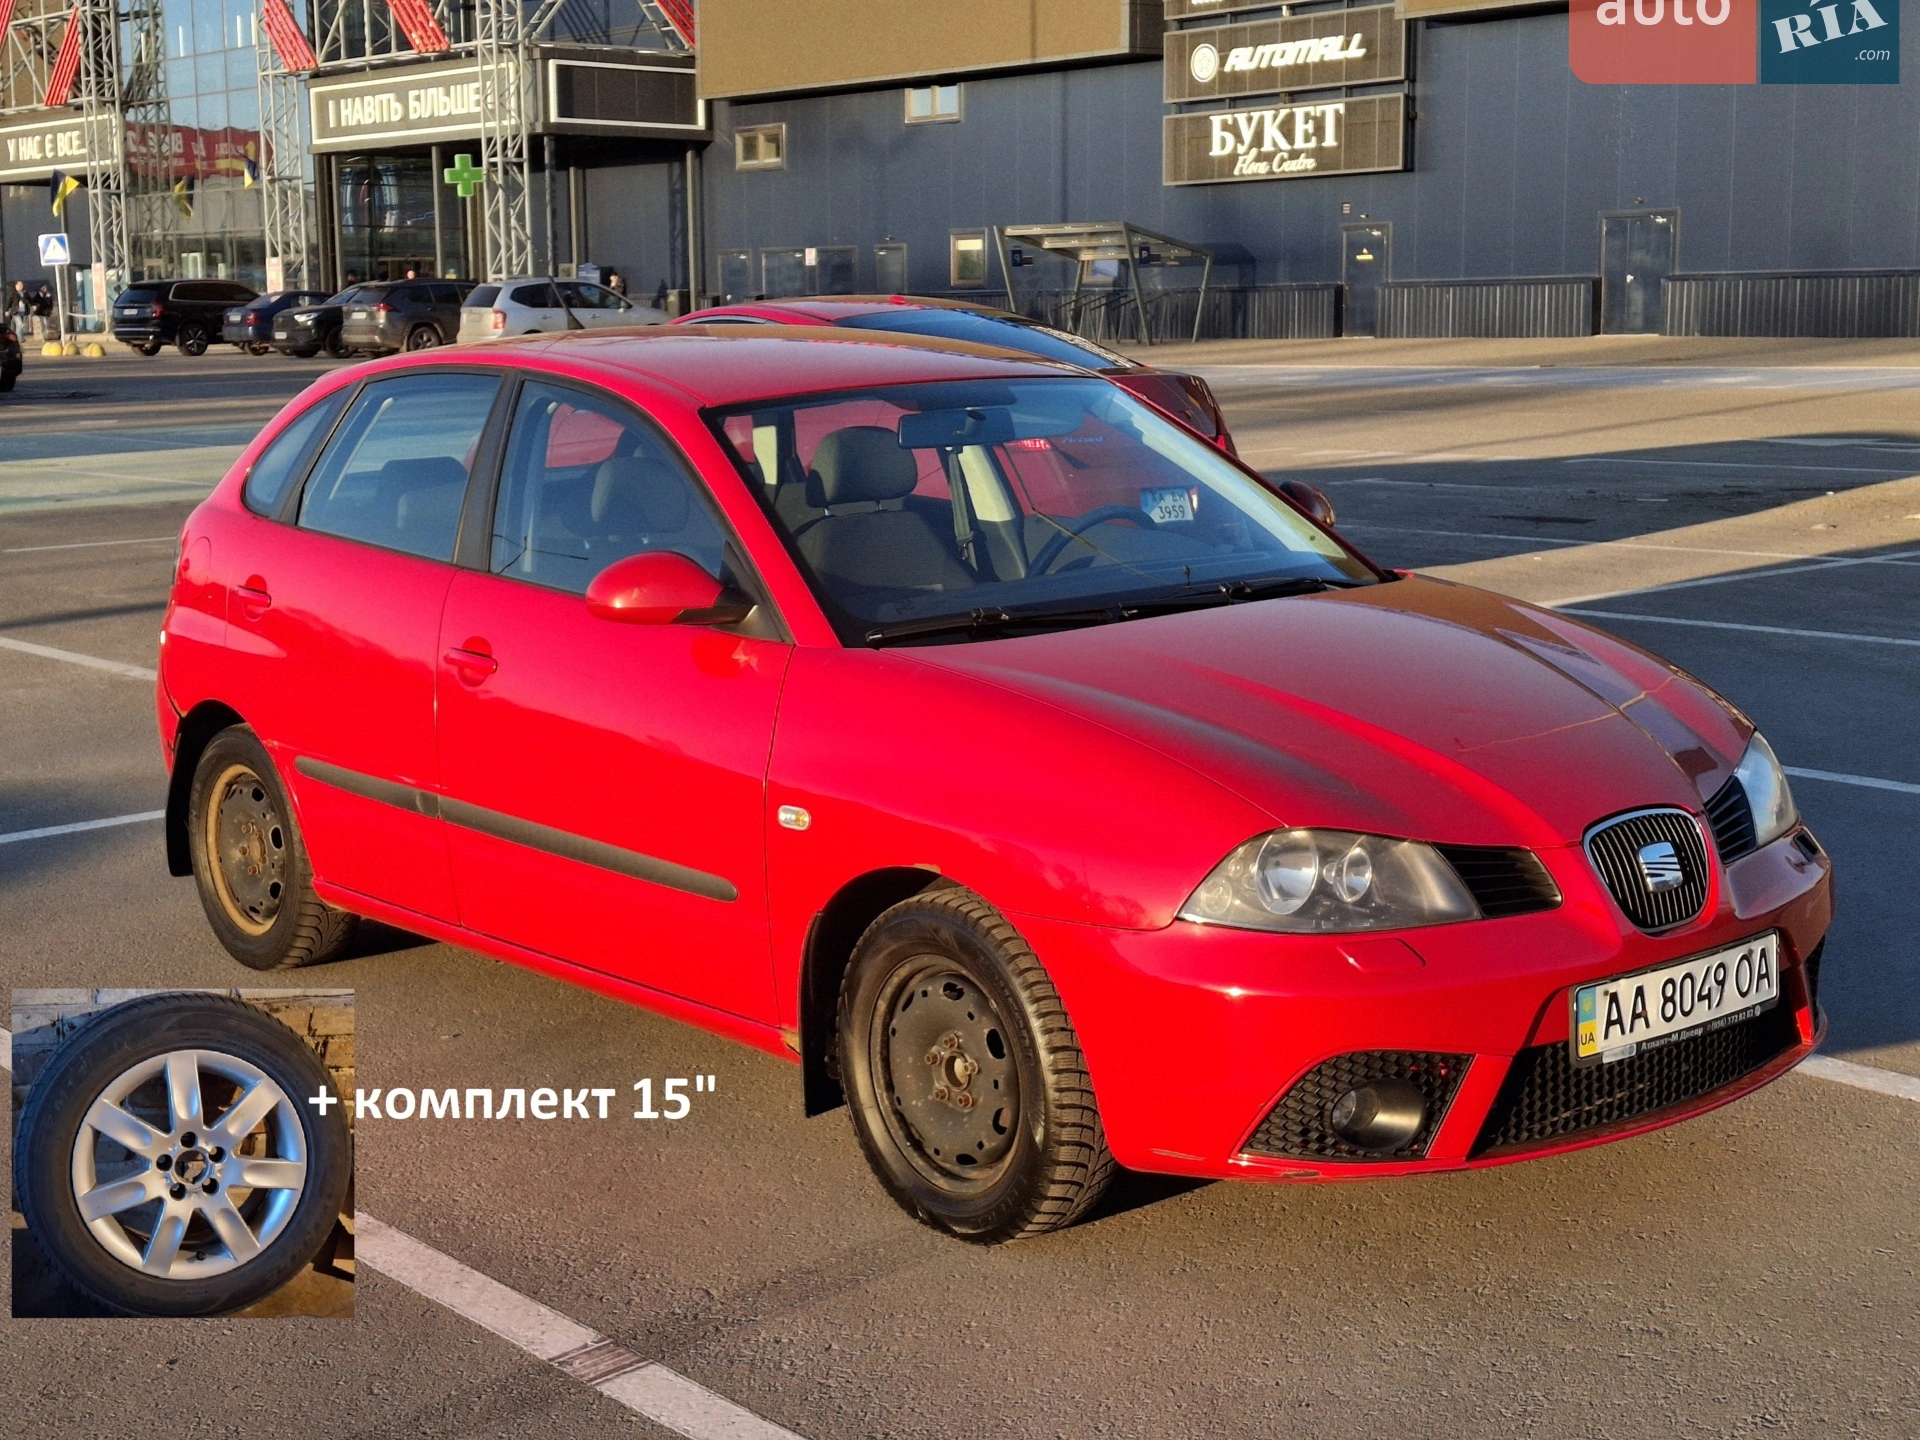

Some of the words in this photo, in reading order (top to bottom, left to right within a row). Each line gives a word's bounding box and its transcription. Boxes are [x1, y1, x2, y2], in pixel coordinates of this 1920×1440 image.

[1224, 32, 1367, 73] AUTOMALL
[340, 92, 404, 127] НАВІТЬ
[1209, 102, 1345, 157] БУКЕТ
[6, 138, 18, 162] У
[18, 135, 43, 161] НАС
[45, 133, 55, 158] Є
[1157, 504, 1185, 520] 3959
[1603, 984, 1650, 1040] AA
[1660, 961, 1727, 1023] 8049
[1734, 947, 1771, 998] OA
[1580, 1032, 1595, 1046] UA
